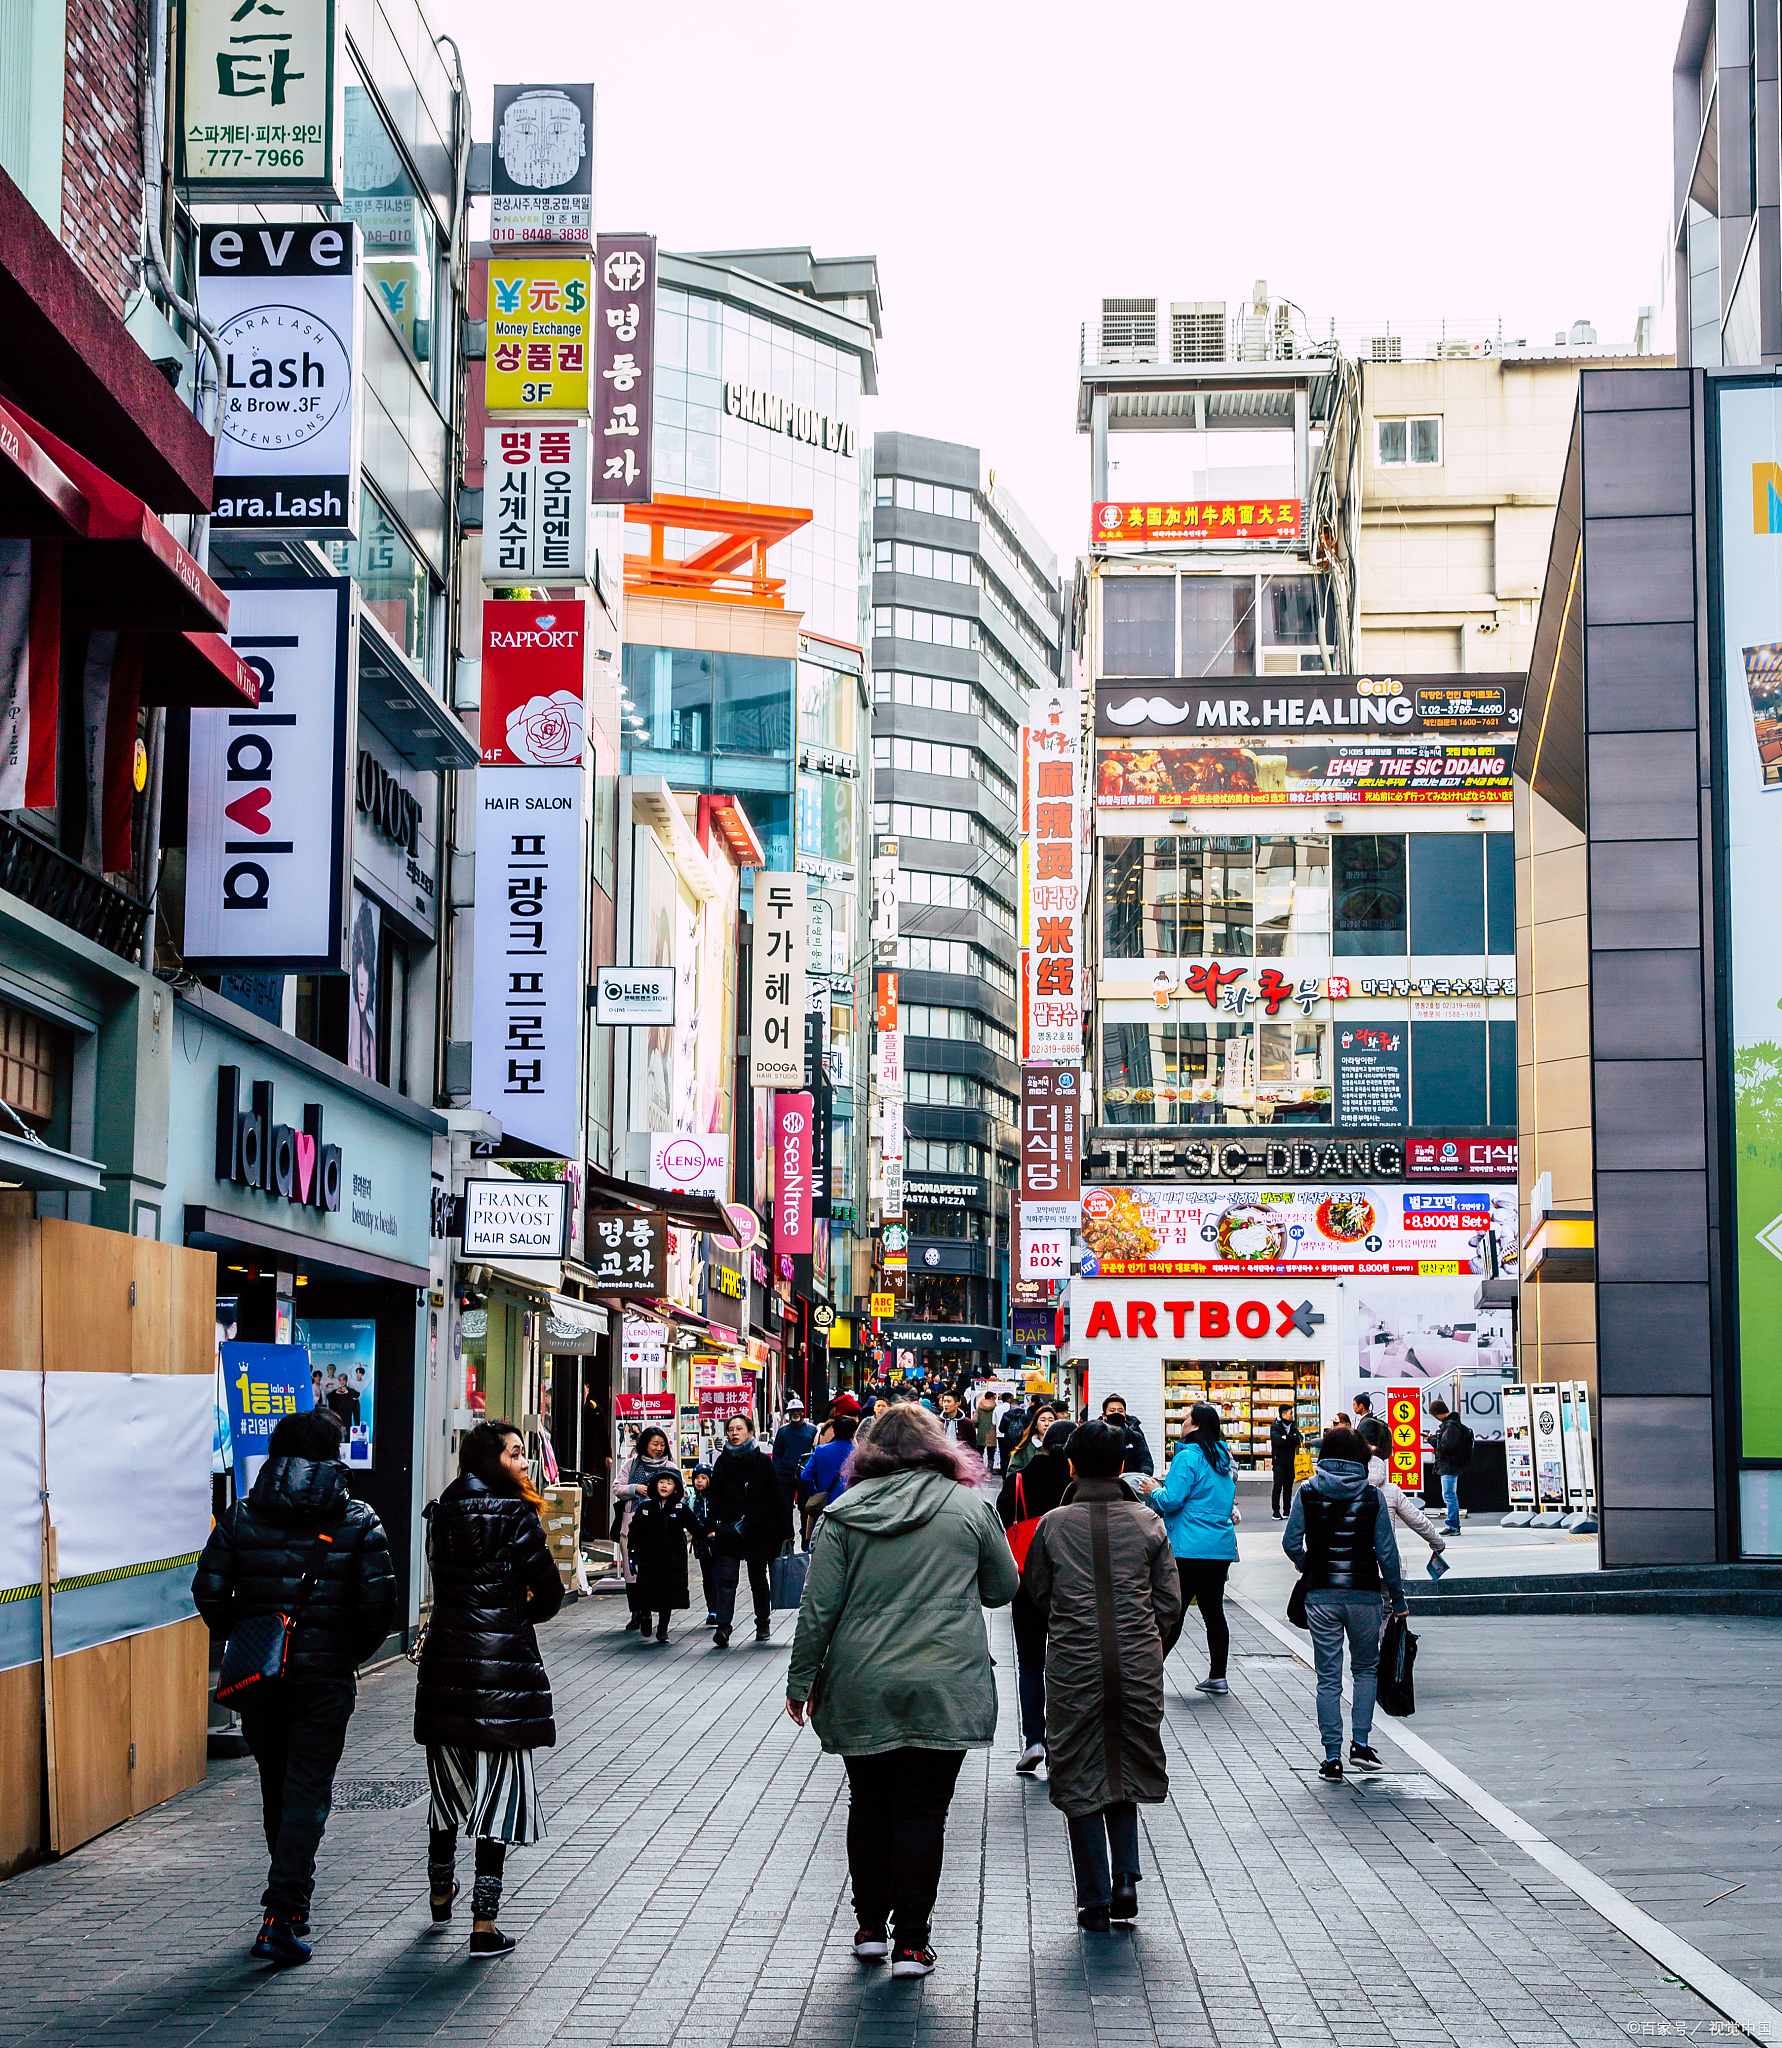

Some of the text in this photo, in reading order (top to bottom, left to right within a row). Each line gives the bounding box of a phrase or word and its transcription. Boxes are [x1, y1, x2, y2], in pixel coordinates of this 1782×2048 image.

[187, 125, 322, 145] 스파게티·피자·와인
[206, 149, 304, 167] 777-7966
[504, 214, 540, 224] NAVER
[492, 227, 589, 241] 010-8448-3838
[496, 321, 583, 338] Money Exchange
[493, 343, 584, 373] 상품권
[226, 352, 325, 389] Lash
[521, 383, 554, 403] 3F
[602, 303, 643, 487] 명동교자
[229, 398, 242, 412] &
[723, 380, 823, 447] CHAMPION
[499, 431, 572, 465] 명품
[209, 491, 341, 518] ara.Lash
[498, 470, 528, 571] 시계수리
[542, 470, 572, 569] 오리엔트
[174, 546, 201, 598] Pasta
[489, 631, 579, 649] RAPPORT
[235, 660, 257, 700] Wine
[1357, 678, 1404, 697] Cafe
[1195, 696, 1414, 729] MR.HEALING
[1459, 718, 1499, 726] 1600-7621
[483, 748, 503, 762] 4F
[1348, 748, 1364, 756] KBS
[1379, 758, 1415, 777] THE
[1413, 758, 1444, 776] SIC
[1443, 757, 1506, 776] DDANG
[356, 750, 423, 858] OVOST
[484, 797, 572, 810] HAIR SALON
[882, 868, 896, 930] 401
[503, 834, 549, 1094] 프랑크 프로보
[764, 887, 794, 1049] 두가헤어
[1033, 1002, 1078, 1028] 쌀국수
[1031, 1043, 1081, 1054] 02)319-6866
[756, 1062, 798, 1073] DOOGA
[1026, 1104, 1062, 1191] 더식당
[667, 1155, 725, 1168] LENS ME
[1100, 1142, 1402, 1177] THE SIC-DDANG
[478, 1192, 550, 1208] FRANCK
[939, 1196, 966, 1207] PIZZA
[1408, 1195, 1458, 1211] 벌교꼬막
[351, 1201, 399, 1238] beauty health
[472, 1211, 555, 1227] PROVOST
[1141, 1208, 1203, 1226] 벌교꼬막
[1411, 1214, 1483, 1229] 8,900원 Set
[474, 1232, 551, 1245] HAIR SALON
[597, 1217, 655, 1248] 명동
[1156, 1227, 1187, 1244] 무침
[1290, 1227, 1304, 1238] or
[1030, 1243, 1061, 1254] ART
[597, 1249, 655, 1278] 교자
[1030, 1256, 1063, 1267] BOX
[1100, 1262, 1126, 1274] 꾸준한
[1127, 1262, 1147, 1274] 인기!
[1148, 1262, 1174, 1274] 더식당
[1358, 1263, 1390, 1273] 8,900원
[873, 1297, 893, 1307] ABC
[873, 1306, 893, 1314] MART
[1039, 1311, 1048, 1325] 6
[1085, 1299, 1325, 1338] ARTBOX
[628, 1329, 663, 1337] LENS ME
[1015, 1328, 1048, 1343] BAR
[640, 1352, 661, 1363] 美瞳
[700, 1391, 750, 1405] 美瞳批发
[1398, 1403, 1410, 1421] $
[1398, 1428, 1412, 1443] ¥
[1397, 1452, 1412, 1466] 元
